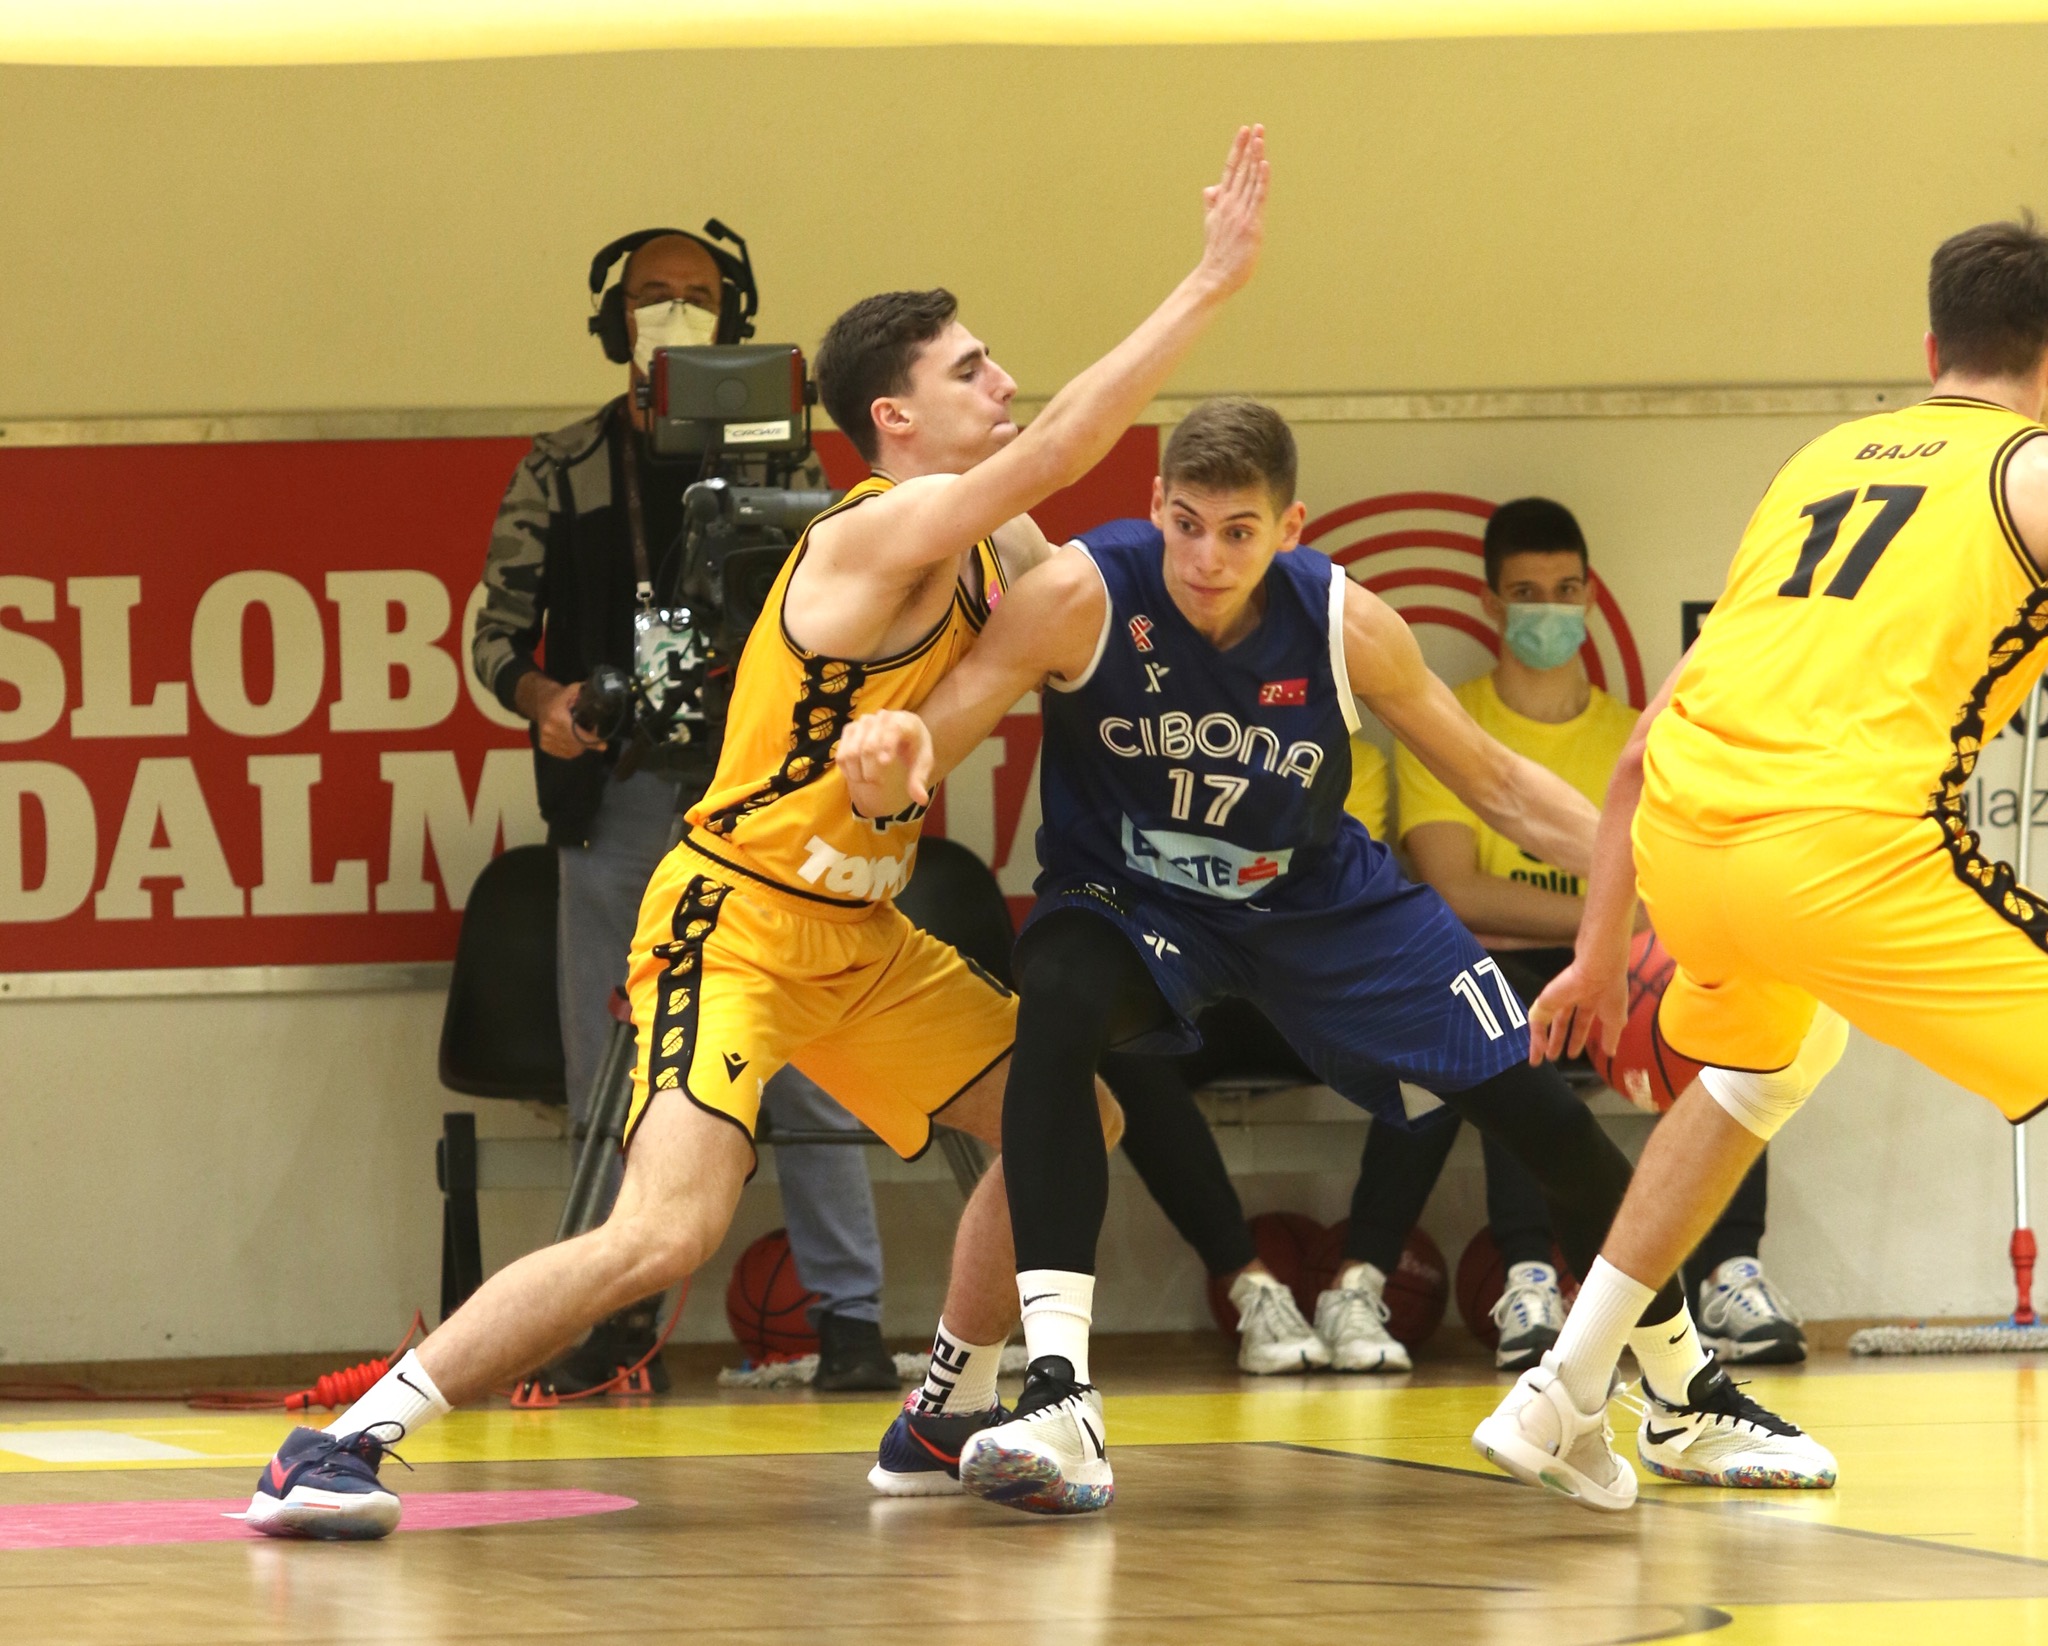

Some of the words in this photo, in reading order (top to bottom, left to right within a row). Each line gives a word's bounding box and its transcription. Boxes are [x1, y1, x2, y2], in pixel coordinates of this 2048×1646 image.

[1854, 440, 1948, 460] BAJO
[1778, 484, 1928, 600] 17
[1099, 711, 1324, 788] CIBONA
[1168, 768, 1250, 827] 17
[1450, 956, 1528, 1041] 17
